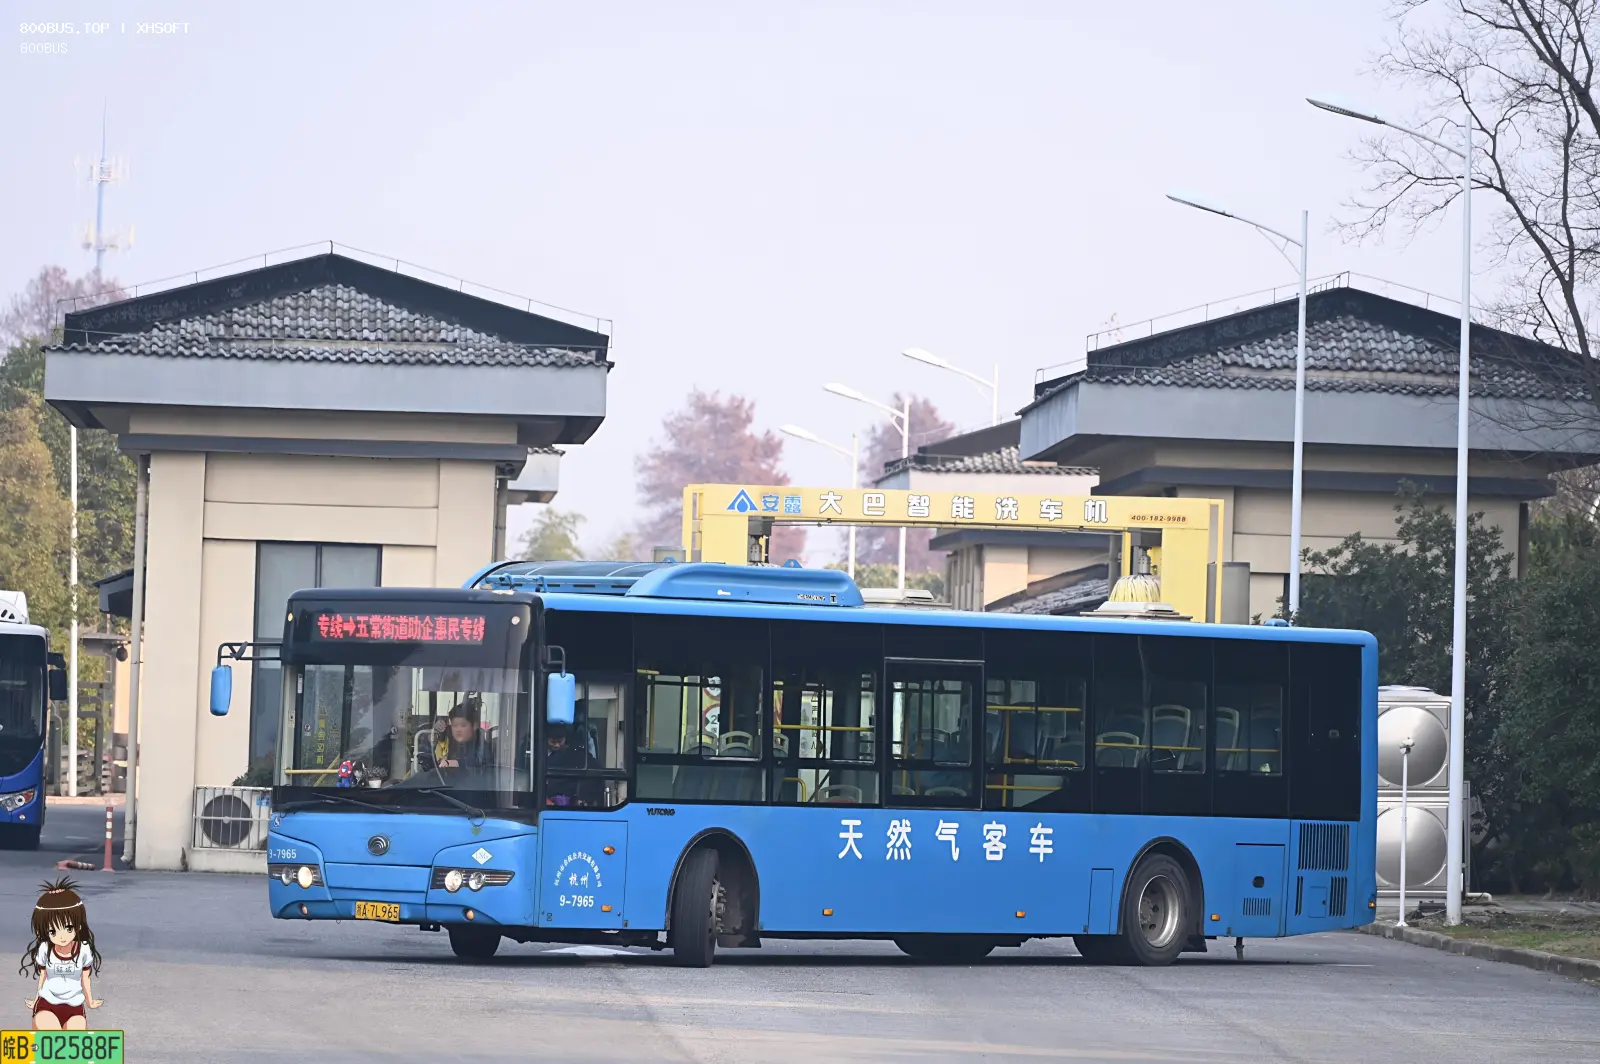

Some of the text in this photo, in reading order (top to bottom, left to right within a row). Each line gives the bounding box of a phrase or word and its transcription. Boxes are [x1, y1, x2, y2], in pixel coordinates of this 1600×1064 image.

[818, 491, 1109, 523] 大巴智能洗车机
[646, 807, 676, 816] YUTONG
[838, 818, 1054, 863] 天然气客车
[568, 872, 589, 889] 杭州
[559, 894, 594, 908] 9-7965
